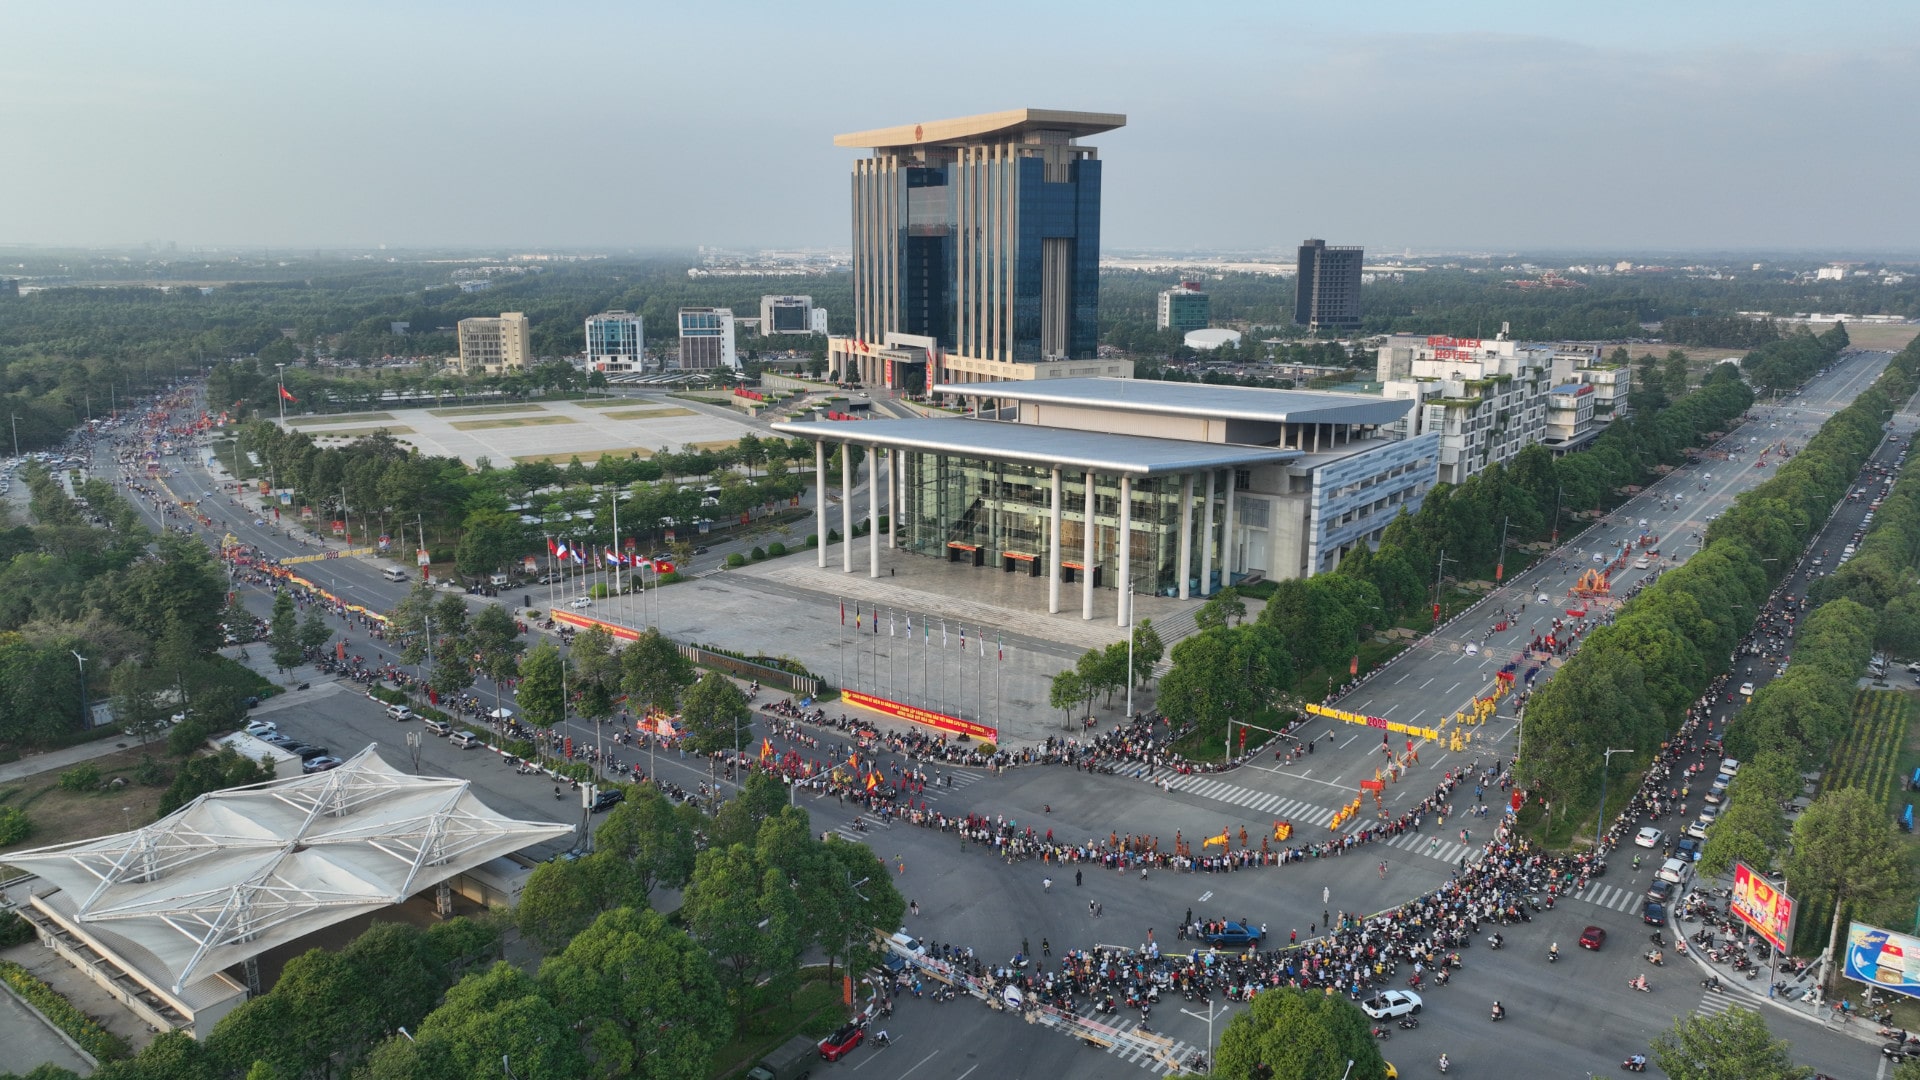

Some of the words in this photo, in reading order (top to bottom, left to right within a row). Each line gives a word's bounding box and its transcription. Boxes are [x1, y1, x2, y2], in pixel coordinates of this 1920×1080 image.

[1428, 336, 1482, 348] BECAMEX
[1435, 349, 1472, 360] HOTEL
[1368, 715, 1387, 730] 2023
